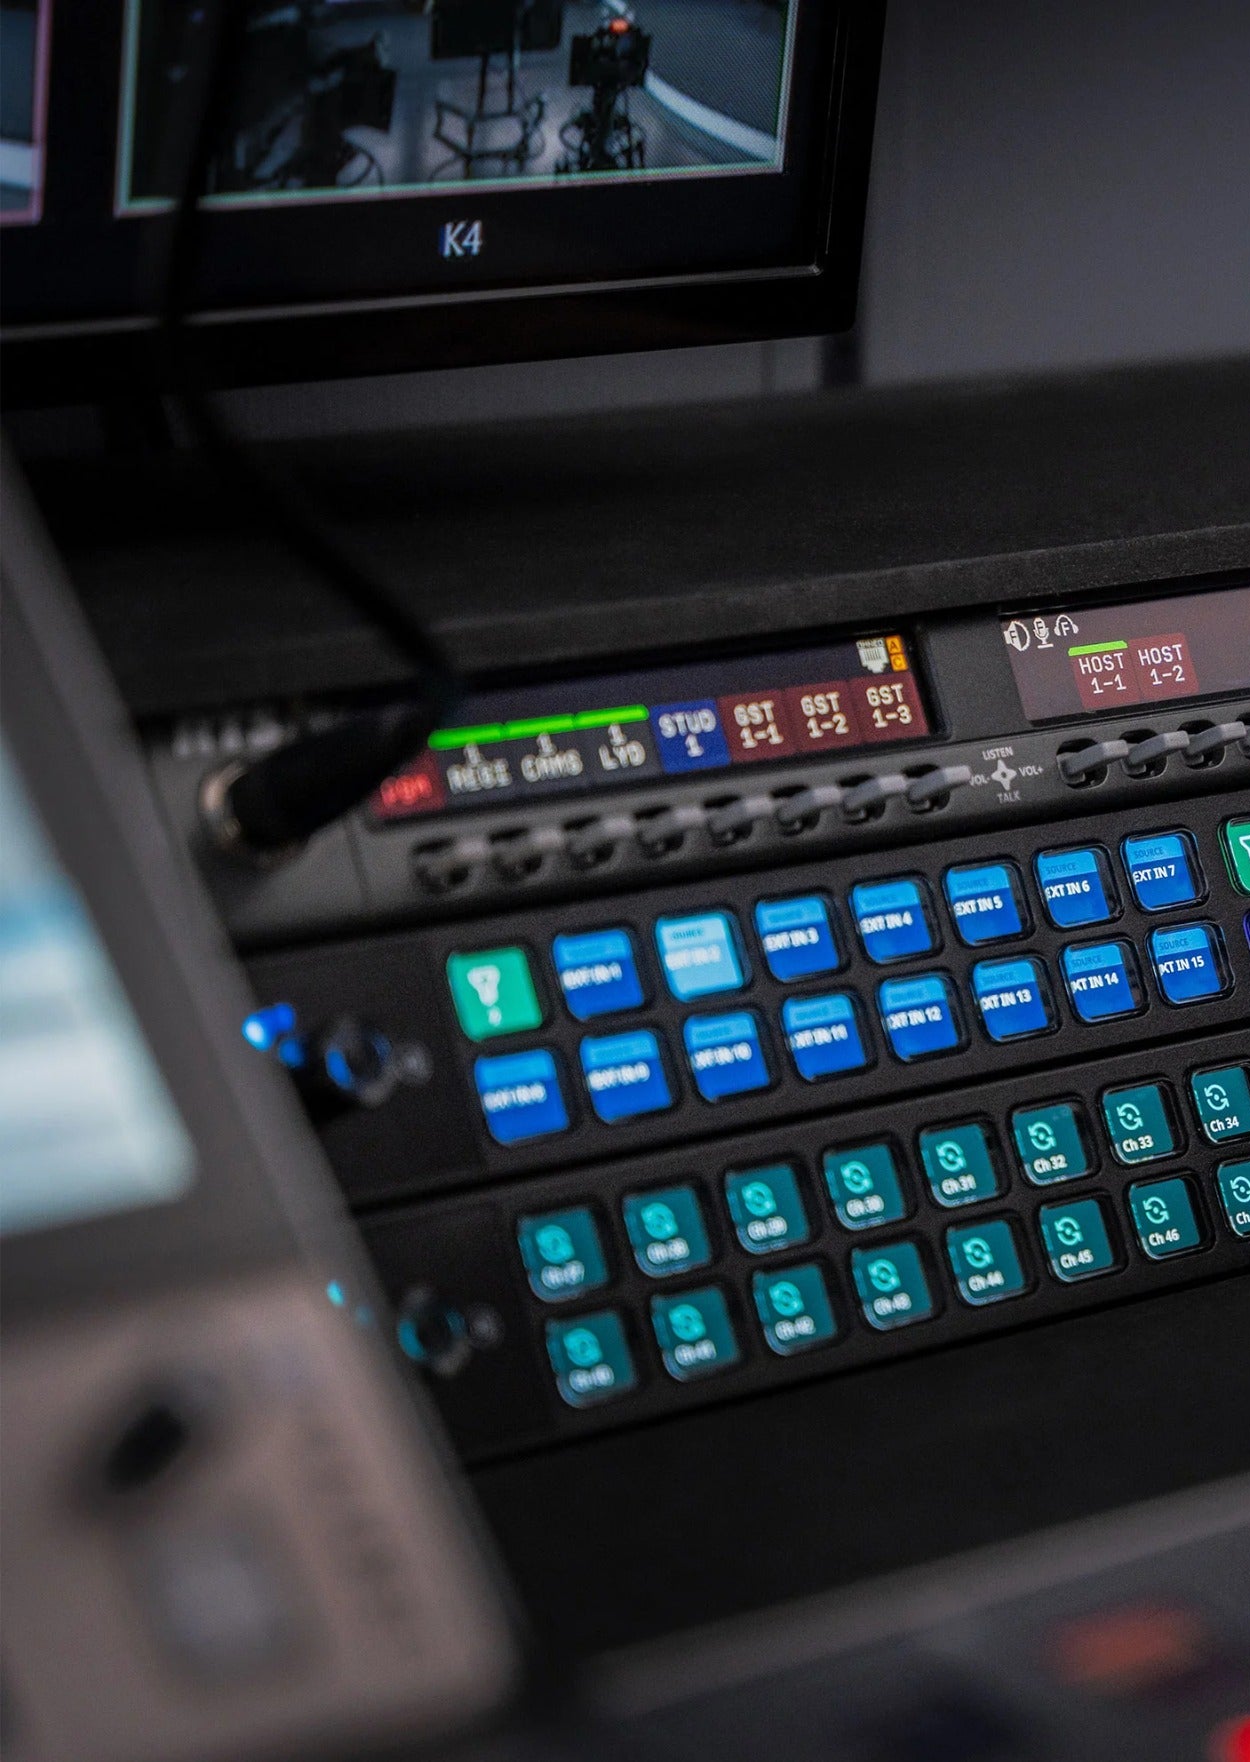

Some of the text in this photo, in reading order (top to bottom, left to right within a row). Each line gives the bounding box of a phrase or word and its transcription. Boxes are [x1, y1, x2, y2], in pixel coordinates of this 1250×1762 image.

[444, 220, 482, 258] K4
[1078, 652, 1124, 675] HOST
[1138, 644, 1183, 666] HOST
[1091, 674, 1127, 695] 1-1
[1150, 665, 1186, 686] 1-2
[800, 692, 840, 717] GST
[866, 683, 904, 707] GST
[658, 708, 717, 739] STUD
[733, 700, 775, 727] GST
[872, 705, 913, 728] 1-3
[740, 722, 784, 749] 1-1
[806, 713, 849, 739] 1-2
[598, 740, 646, 771] LYD
[685, 733, 705, 758] 1
[982, 746, 1014, 761] LISTEN
[1018, 765, 1044, 777] VOL+
[997, 790, 1020, 804] TALK
[1133, 847, 1164, 859] SOURCE
[1152, 865, 1169, 879] IN
[1168, 865, 1176, 877] 7
[1065, 881, 1082, 896] IN
[1081, 880, 1091, 893] 6
[976, 896, 995, 912] IN
[992, 895, 1004, 909] 5
[1158, 938, 1189, 950] SOURCE
[1175, 958, 1190, 971] IN
[1191, 955, 1205, 968] 15
[1088, 974, 1104, 989] IN
[1104, 972, 1119, 985] 14
[999, 991, 1017, 1007] IN
[1016, 988, 1032, 1003] 13
[1210, 1116, 1239, 1132] Ch 34
[1121, 1135, 1154, 1153] Ch 33
[1033, 1154, 1068, 1174] Ch 32
[1235, 1211, 1250, 1225] Ch
[1148, 1229, 1180, 1247] Ch 46
[1060, 1249, 1094, 1269] Ch 45
